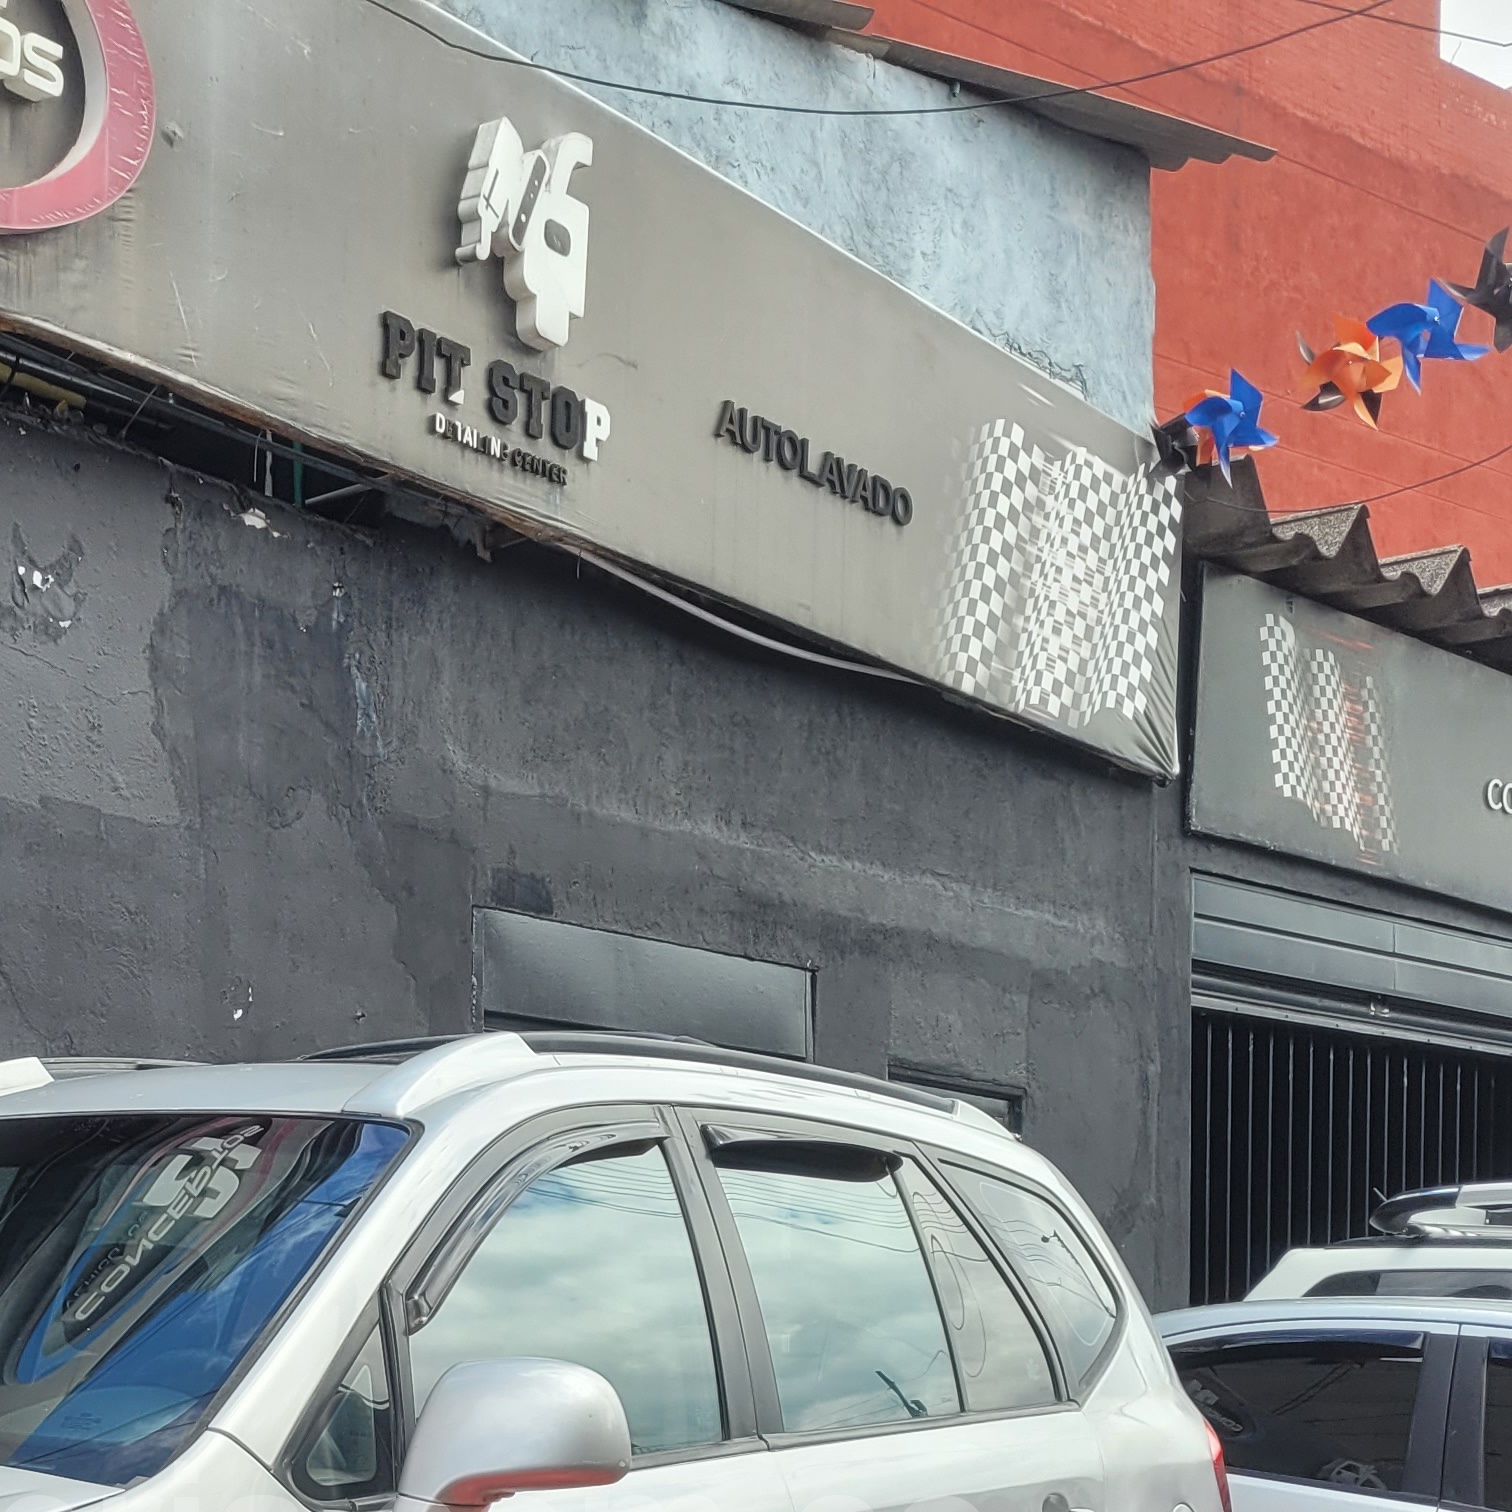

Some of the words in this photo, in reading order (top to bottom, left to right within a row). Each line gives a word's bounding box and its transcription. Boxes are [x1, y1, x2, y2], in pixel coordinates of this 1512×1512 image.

[382, 310, 472, 405] PIT
[488, 359, 611, 462] STOP
[511, 447, 569, 486] CENTER
[714, 399, 914, 527] AUTOLAVADO
